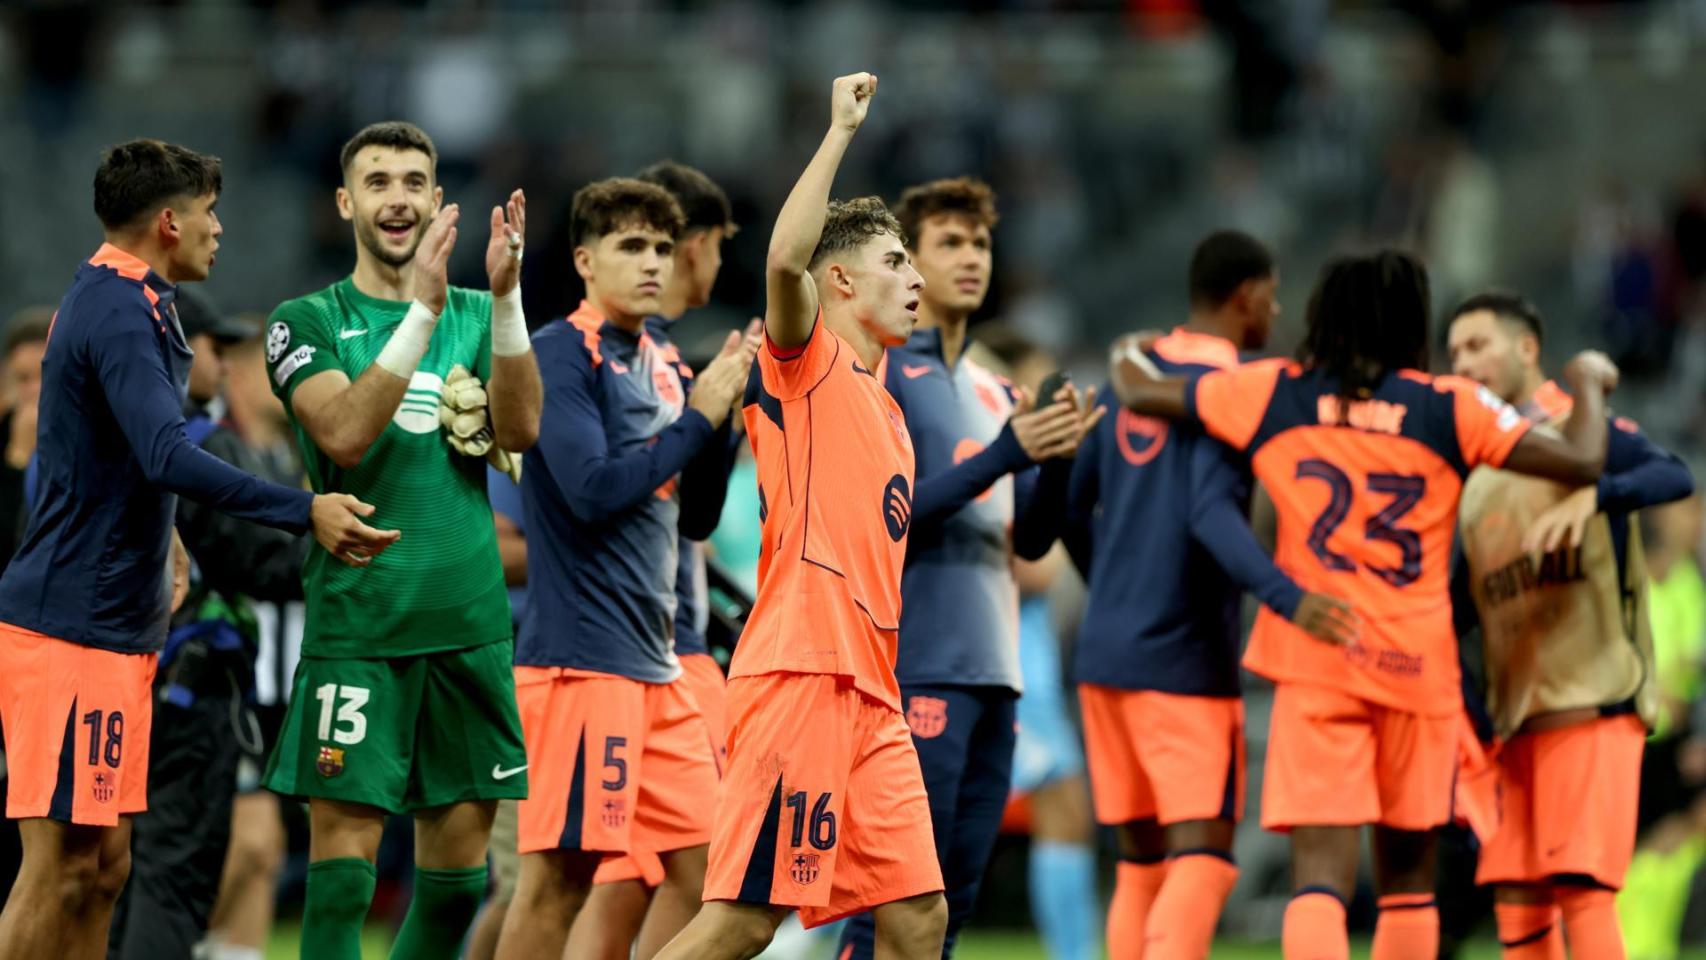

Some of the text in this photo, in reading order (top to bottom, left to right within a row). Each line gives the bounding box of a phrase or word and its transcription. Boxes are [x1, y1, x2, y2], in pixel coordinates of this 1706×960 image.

[1296, 458, 1426, 588] 23
[83, 709, 124, 769] 18
[316, 683, 370, 745] 13
[602, 736, 627, 792] 5
[787, 791, 836, 850] 16
